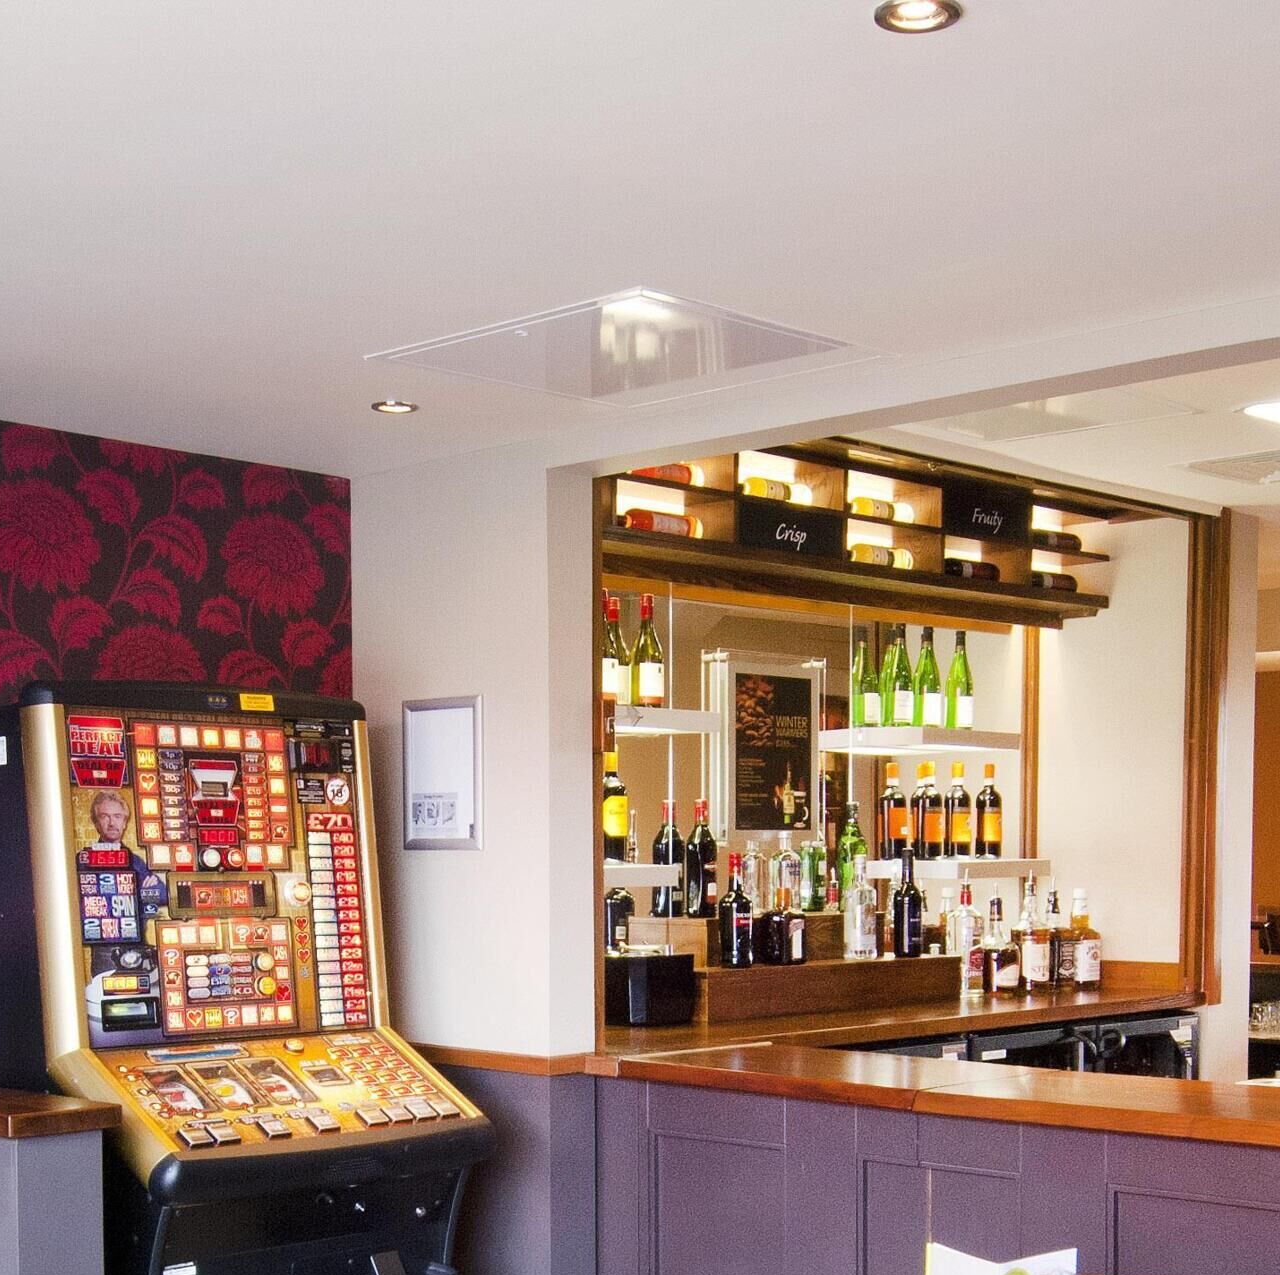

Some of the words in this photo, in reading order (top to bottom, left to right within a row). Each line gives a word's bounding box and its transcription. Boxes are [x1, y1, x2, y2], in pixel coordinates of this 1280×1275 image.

[971, 507, 1004, 535] Fruity
[774, 522, 808, 552] Crisp
[775, 715, 808, 728] WINTER
[70, 731, 123, 742] PERFECT
[71, 741, 124, 757] DEAL
[307, 813, 353, 830] £70
[332, 832, 354, 844] £40
[333, 845, 355, 857] £20
[99, 873, 115, 885] 3
[116, 873, 134, 884] HOT
[84, 896, 107, 906] MEGA
[111, 895, 135, 917] SPIN
[83, 918, 100, 930] 2
[340, 934, 361, 946] £4
[341, 947, 362, 959] £3
